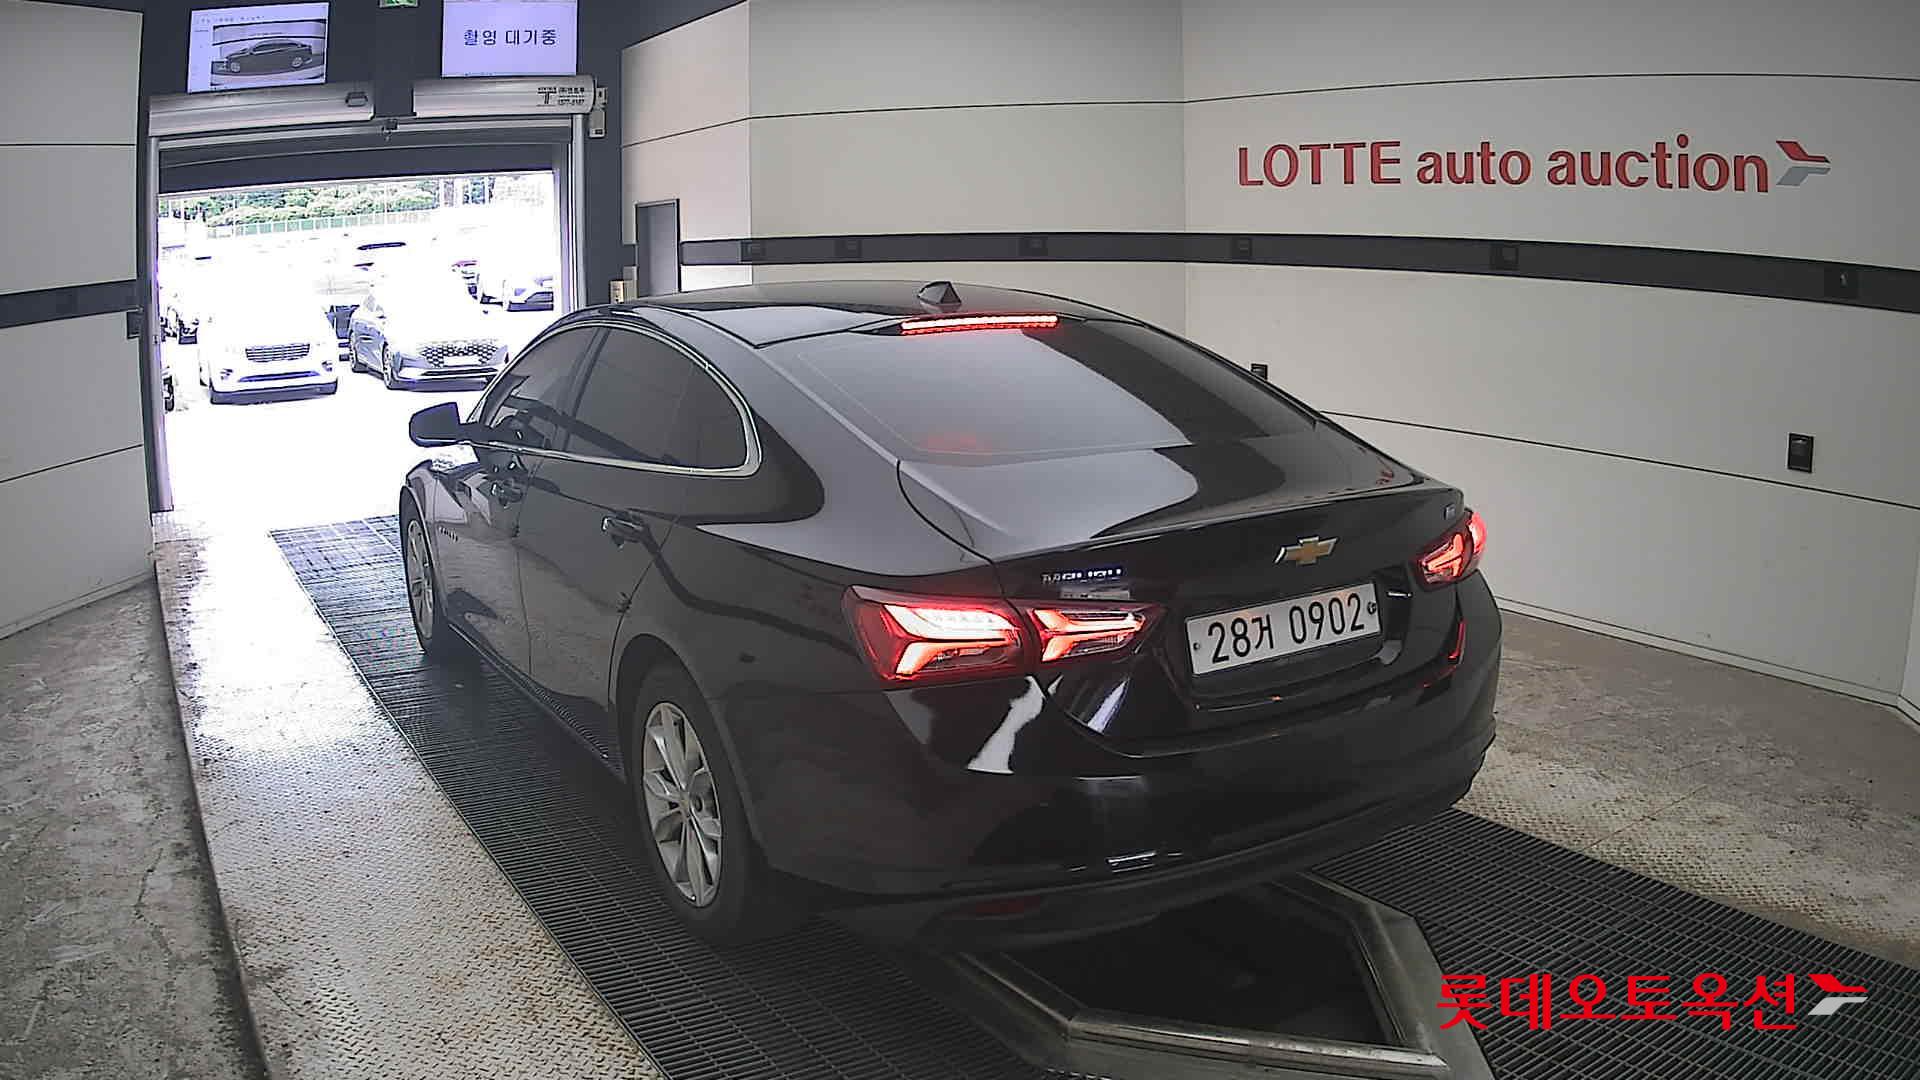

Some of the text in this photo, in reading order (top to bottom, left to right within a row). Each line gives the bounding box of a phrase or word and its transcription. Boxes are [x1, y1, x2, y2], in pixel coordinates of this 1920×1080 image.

[505, 29, 557, 46] 대기중
[1239, 134, 1769, 193] LOTTE auto auction
[1207, 592, 1365, 664] 28거 0902
